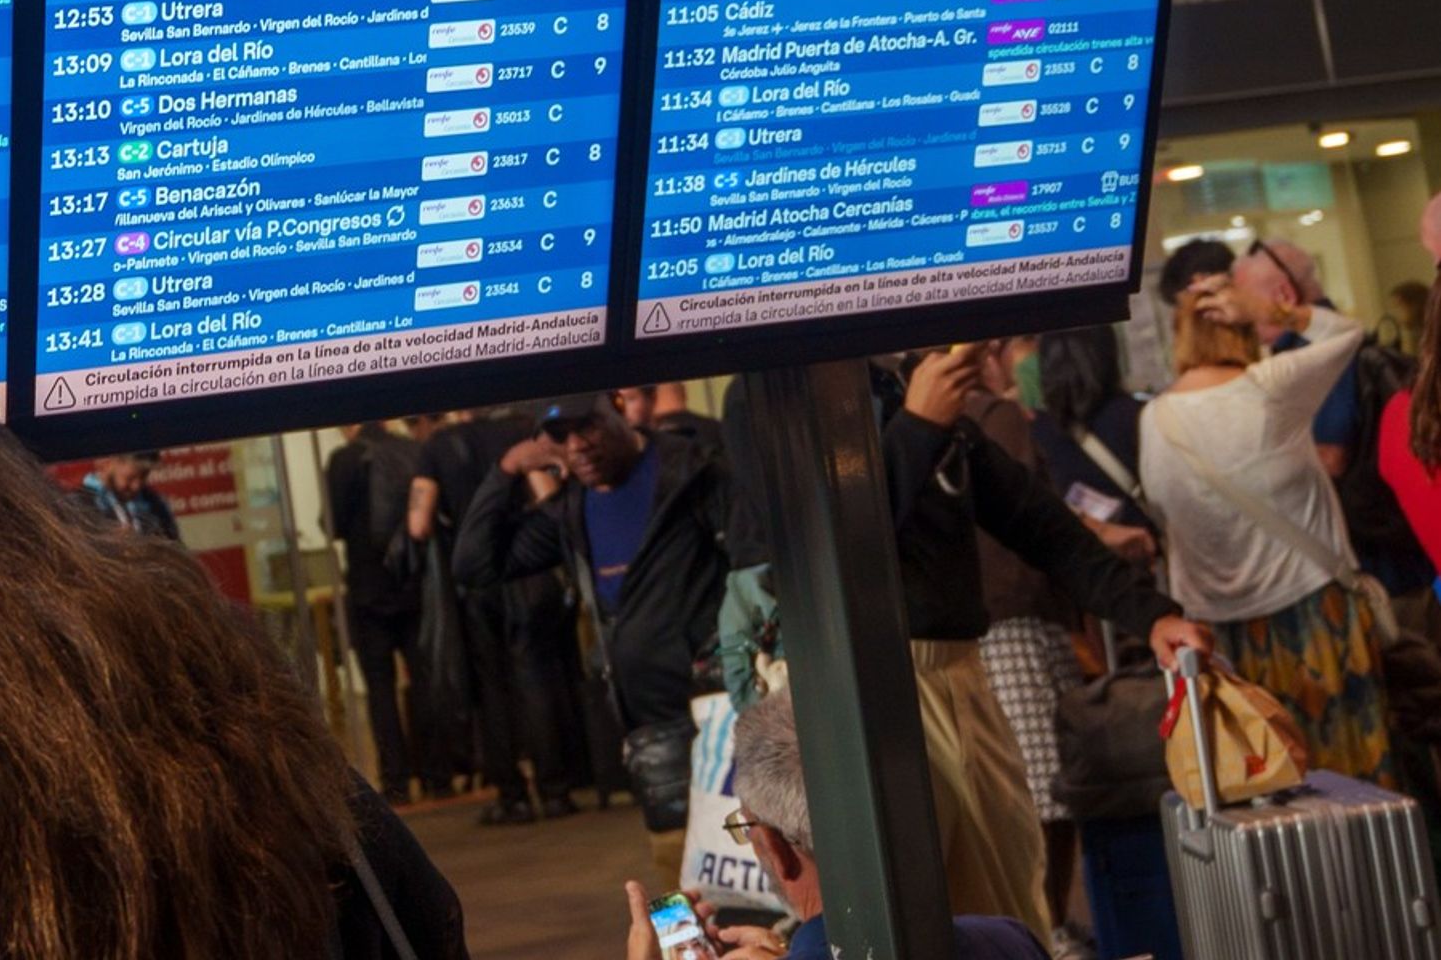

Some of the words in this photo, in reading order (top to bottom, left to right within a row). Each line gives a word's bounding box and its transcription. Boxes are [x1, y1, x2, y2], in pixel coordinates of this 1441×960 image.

[664, 48, 715, 68] 11:32
[722, 42, 782, 64] Madrid
[785, 39, 840, 58] Puerta
[843, 37, 865, 54] de
[868, 30, 950, 52] Atocha-A.
[954, 28, 977, 45] Gr.
[52, 100, 111, 123] 13:10
[121, 97, 149, 115] C-5
[158, 95, 196, 114] Dos
[201, 88, 297, 110] Hermanas
[498, 66, 532, 80] 23717
[551, 61, 565, 78] C
[594, 57, 606, 74] 9
[651, 216, 702, 237] 11:50
[708, 209, 767, 231] Madrid
[770, 205, 829, 225] Atocha
[833, 196, 913, 218] Cercanías
[679, 292, 755, 312] Circulación
[757, 283, 841, 303] interrumpida
[844, 283, 860, 293] en
[863, 279, 875, 291] la
[877, 276, 908, 289] línea
[911, 273, 927, 285] de
[930, 270, 954, 283] alta
[956, 262, 1017, 280] velocidad
[1018, 250, 1125, 272] Madrid-Andalucía
[85, 364, 172, 386] Circulación
[176, 352, 272, 376] interrumpida
[276, 352, 294, 363] en
[298, 348, 310, 360] la
[315, 345, 350, 358] línea
[353, 340, 371, 354] de
[375, 337, 401, 351] alta
[405, 326, 474, 347] velocidad
[477, 311, 599, 338] Madrid-Andalucía
